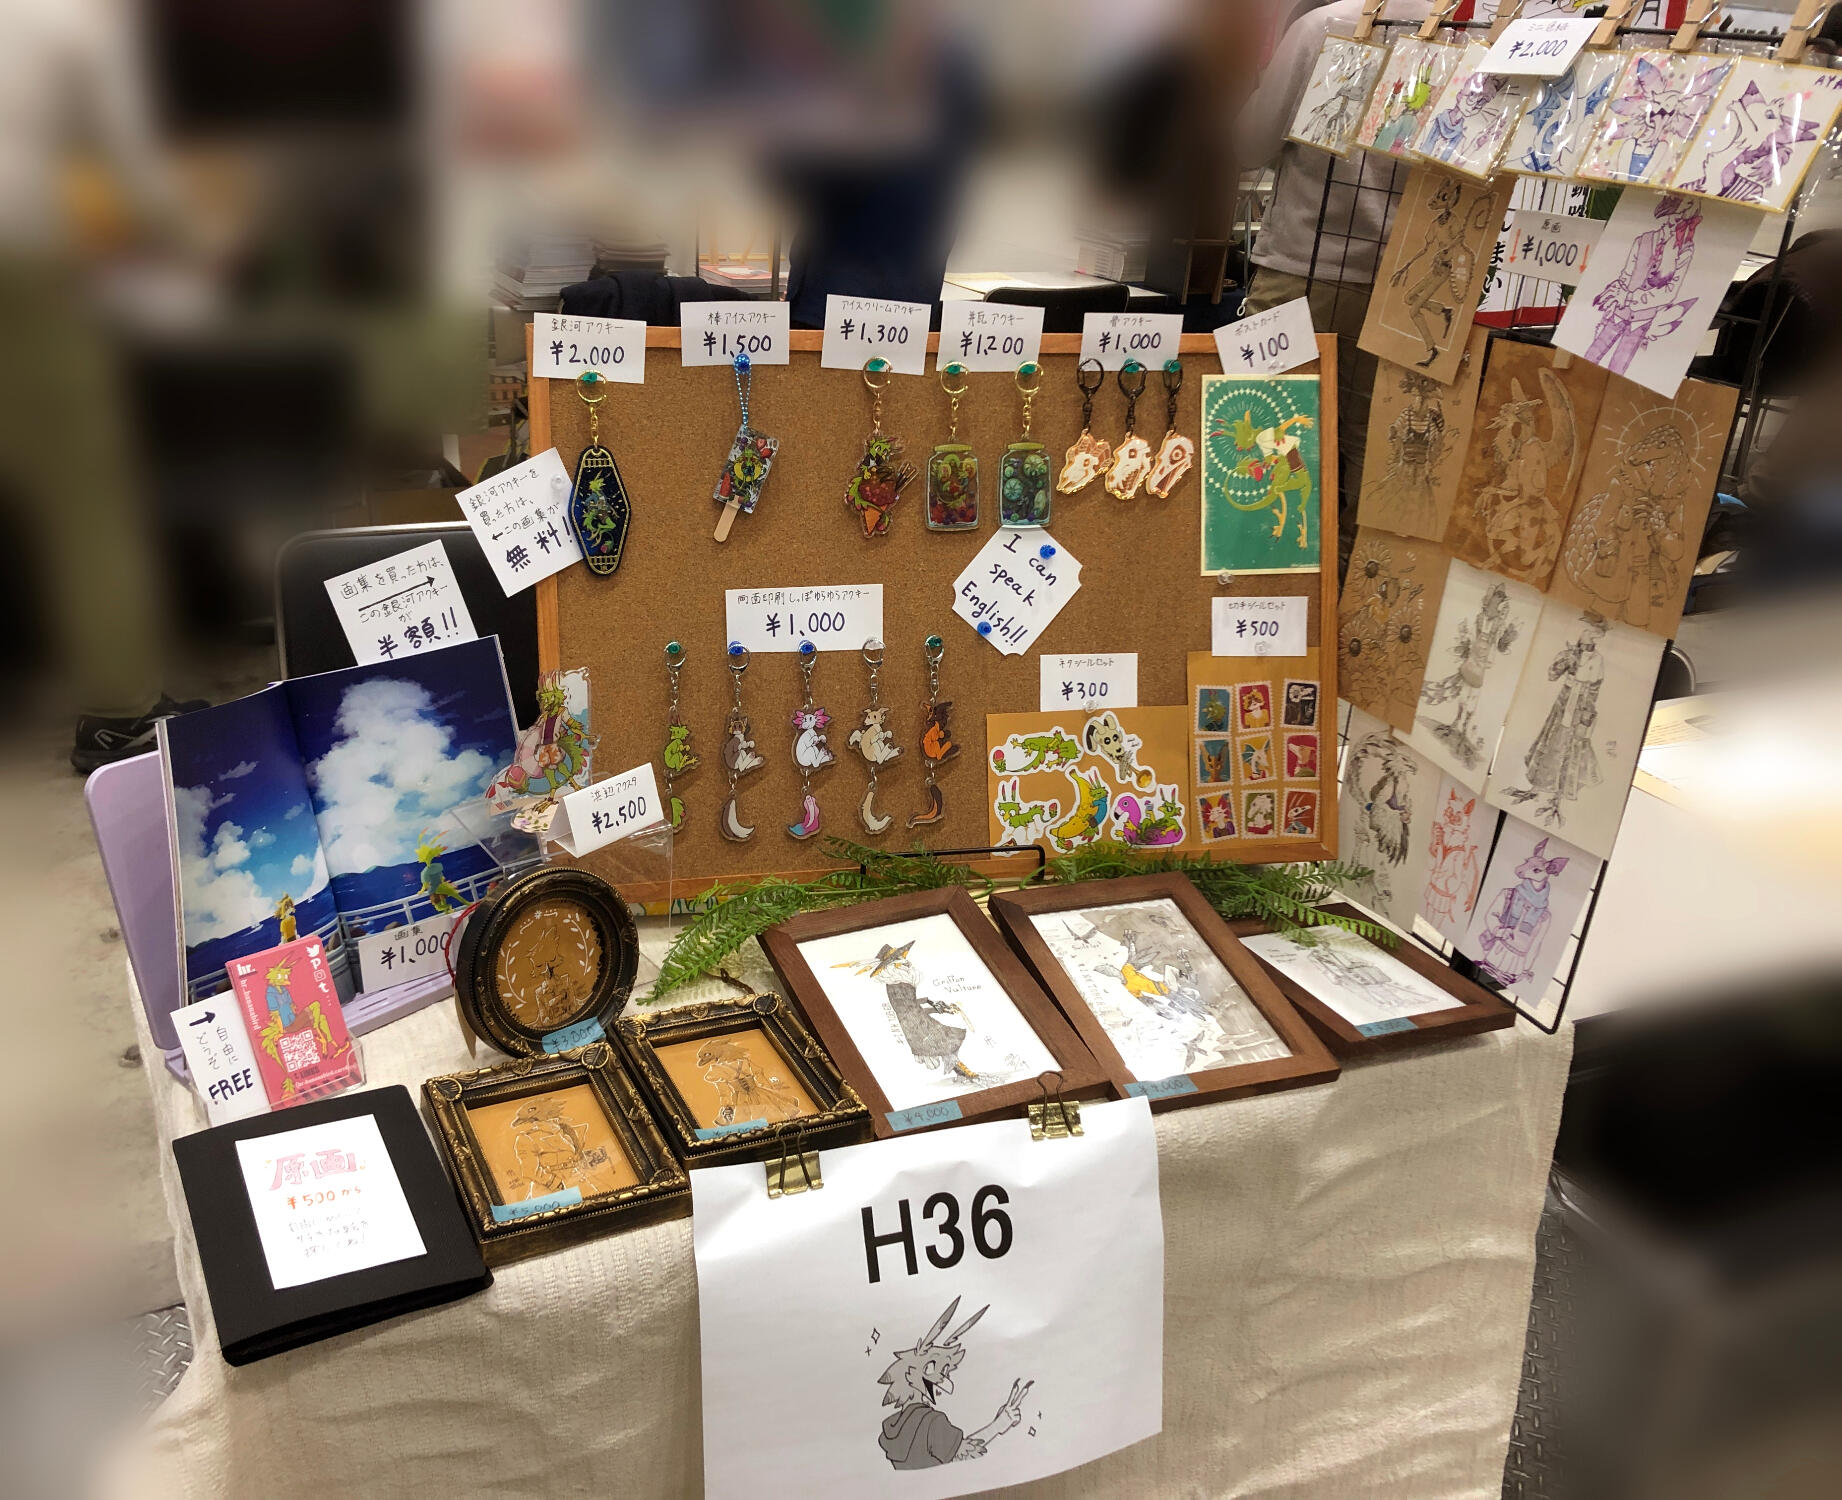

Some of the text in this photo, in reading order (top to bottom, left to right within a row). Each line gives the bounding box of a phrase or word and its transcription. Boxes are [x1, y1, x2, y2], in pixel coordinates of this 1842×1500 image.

[1508, 39, 1568, 60] ¥2,000
[1521, 235, 1578, 267] ¥1,000
[708, 311, 777, 326] 棒アイスアクキー
[841, 300, 922, 315] アイスクリームアクキー
[551, 318, 625, 334] 銀河アクキー
[840, 318, 909, 344] ¥1,300
[550, 340, 625, 366] ¥2,000
[703, 331, 772, 358] ¥1,500
[960, 331, 1024, 357] ¥1,200
[1099, 331, 1162, 354] ¥1,000
[1239, 332, 1290, 368] ¥100
[469, 468, 540, 513] 銀河アクキーを
[504, 502, 560, 535] この画集が
[1003, 533, 1057, 586] I can
[989, 563, 1036, 607] speak
[766, 611, 846, 637] ¥1,000
[961, 580, 1029, 647] English!!
[1236, 619, 1279, 639] ¥500
[1061, 680, 1109, 701] ¥300
[592, 796, 647, 835] ¥2,500
[394, 924, 424, 941] 画集
[208, 1067, 254, 1104] FREE
[268, 1149, 358, 1191] 原画
[861, 1184, 1014, 1284] H36
